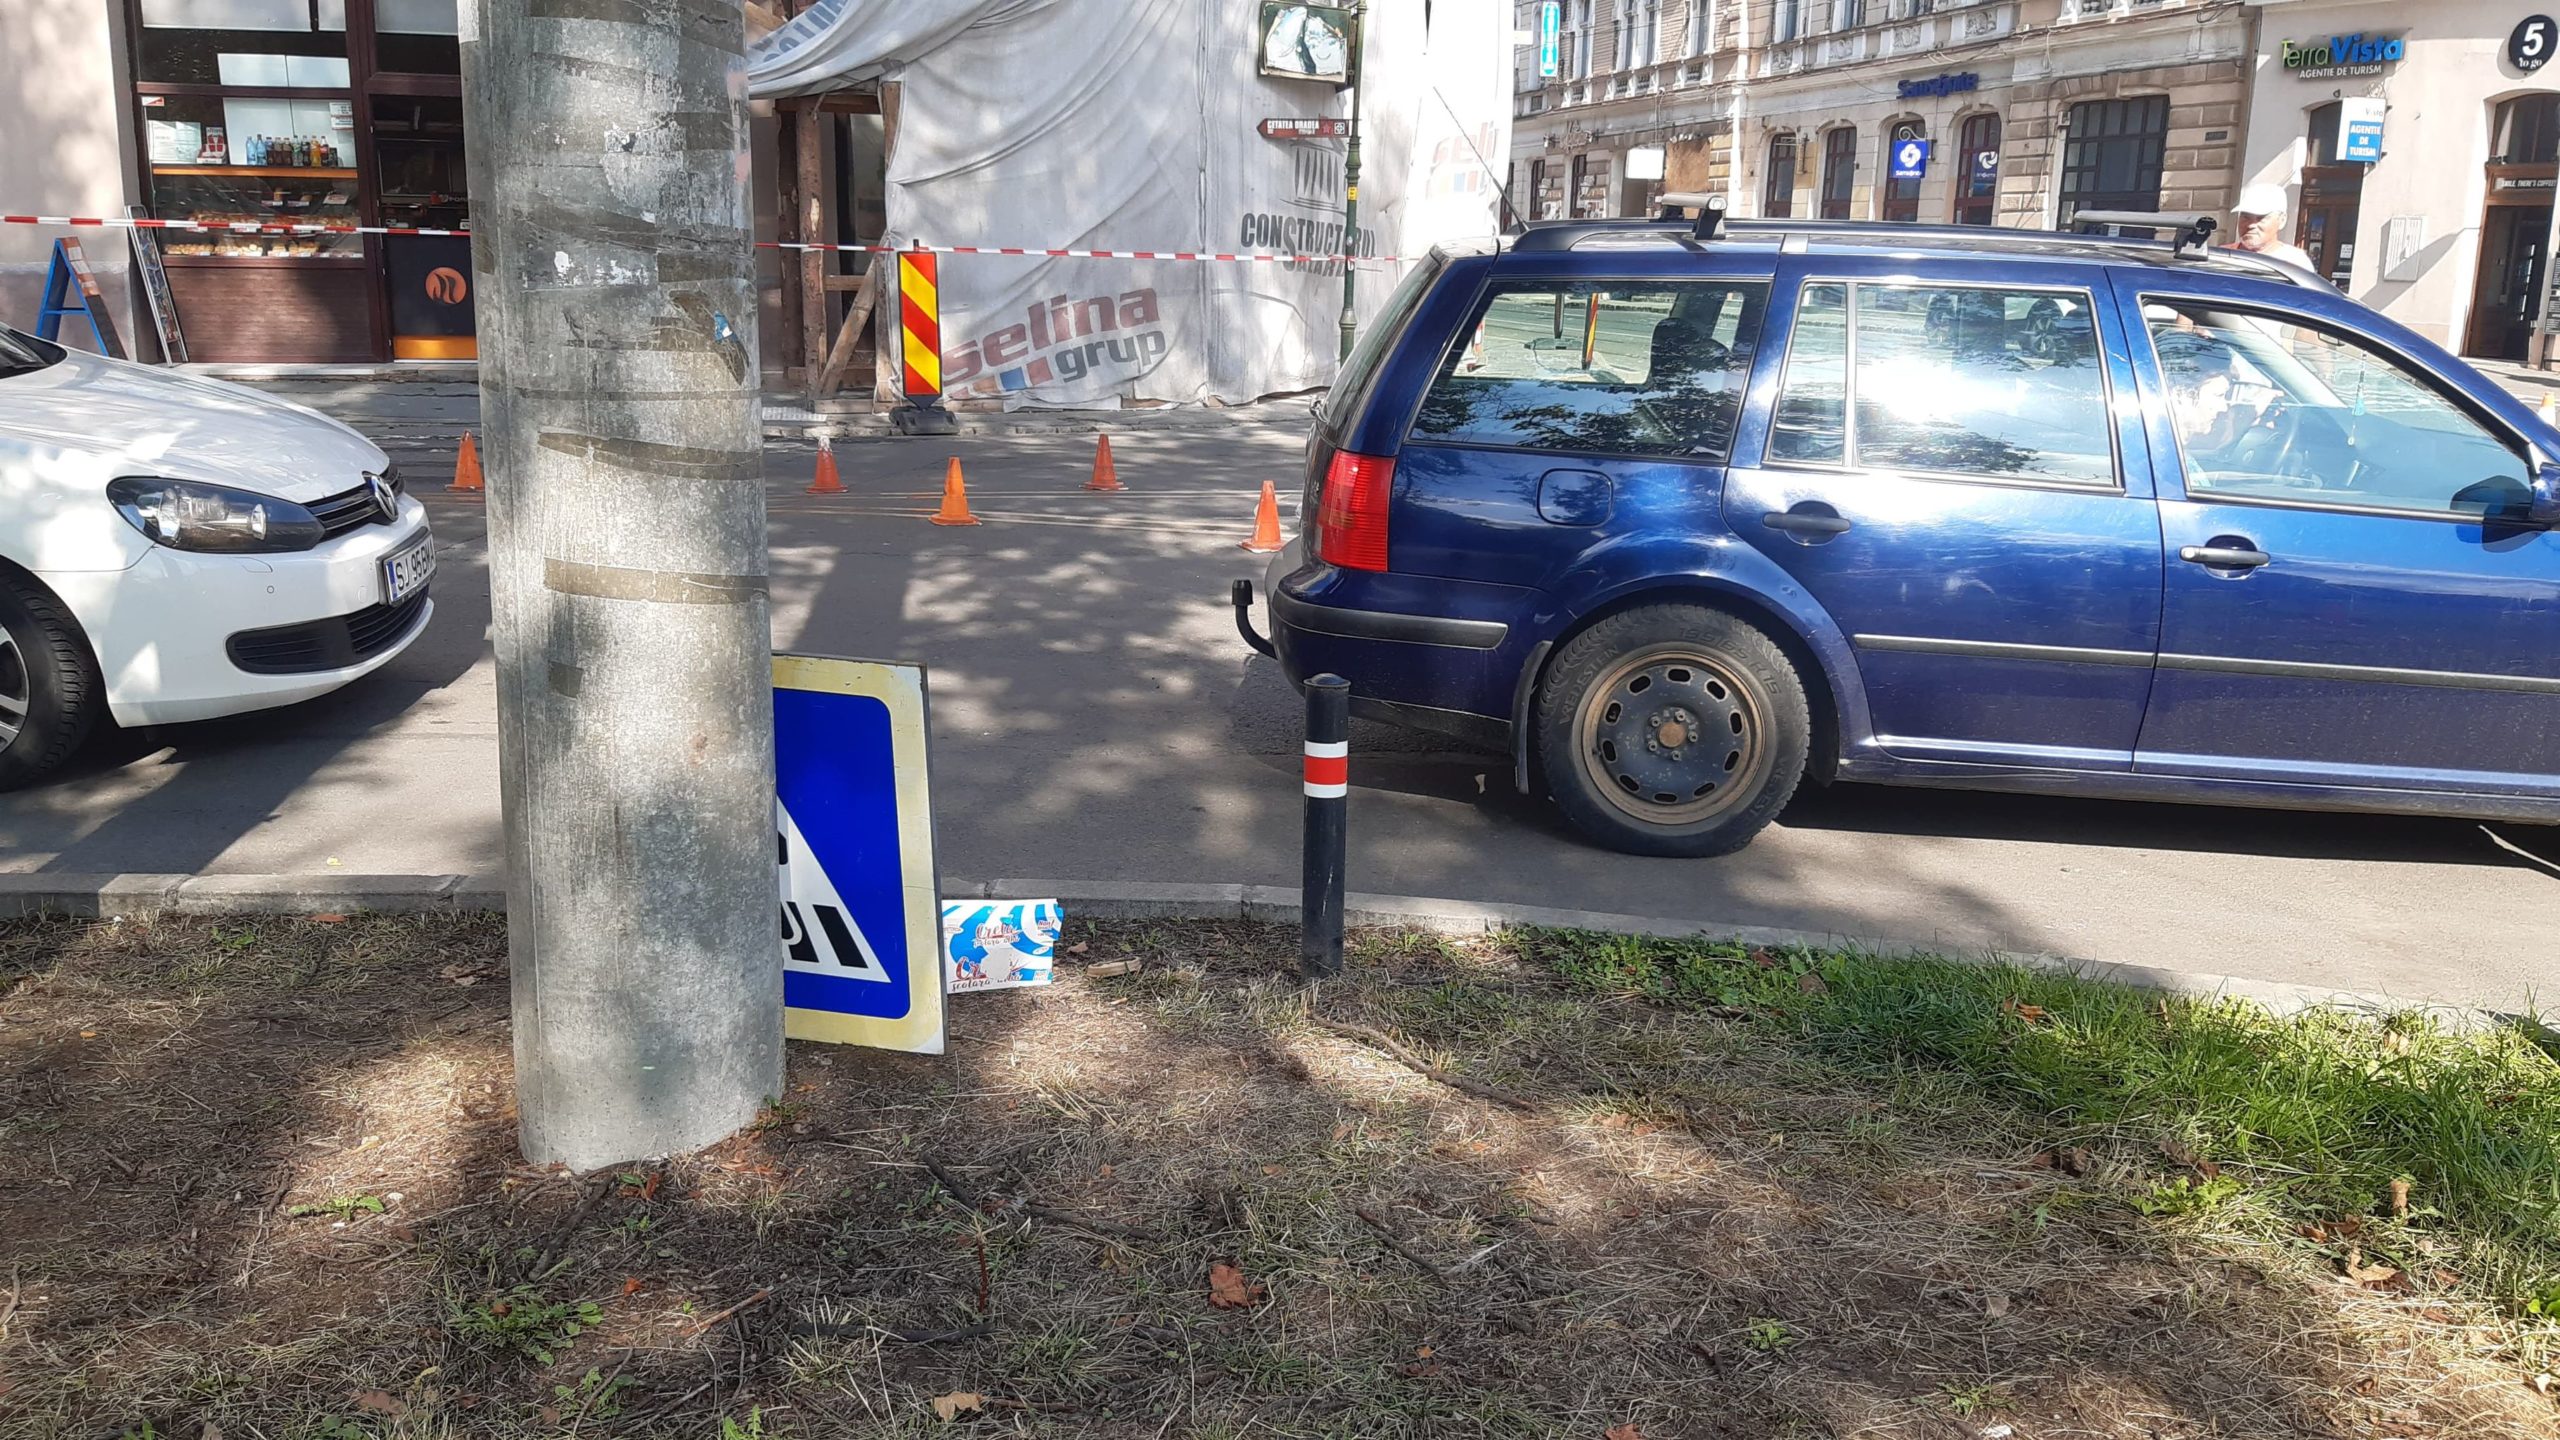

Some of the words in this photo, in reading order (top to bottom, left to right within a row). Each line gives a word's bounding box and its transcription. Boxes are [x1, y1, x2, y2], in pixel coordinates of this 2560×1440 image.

[2522, 22, 2545, 56] 5
[2299, 67, 2334, 79] AGENTIE
[2336, 67, 2348, 77] DE
[2350, 65, 2382, 76] TURISM
[2519, 57, 2529, 68] to
[2530, 59, 2543, 70] go
[1241, 213, 1376, 272] CONSTRUCTRUL
[941, 287, 1161, 388] selina
[1054, 330, 1167, 383] grup
